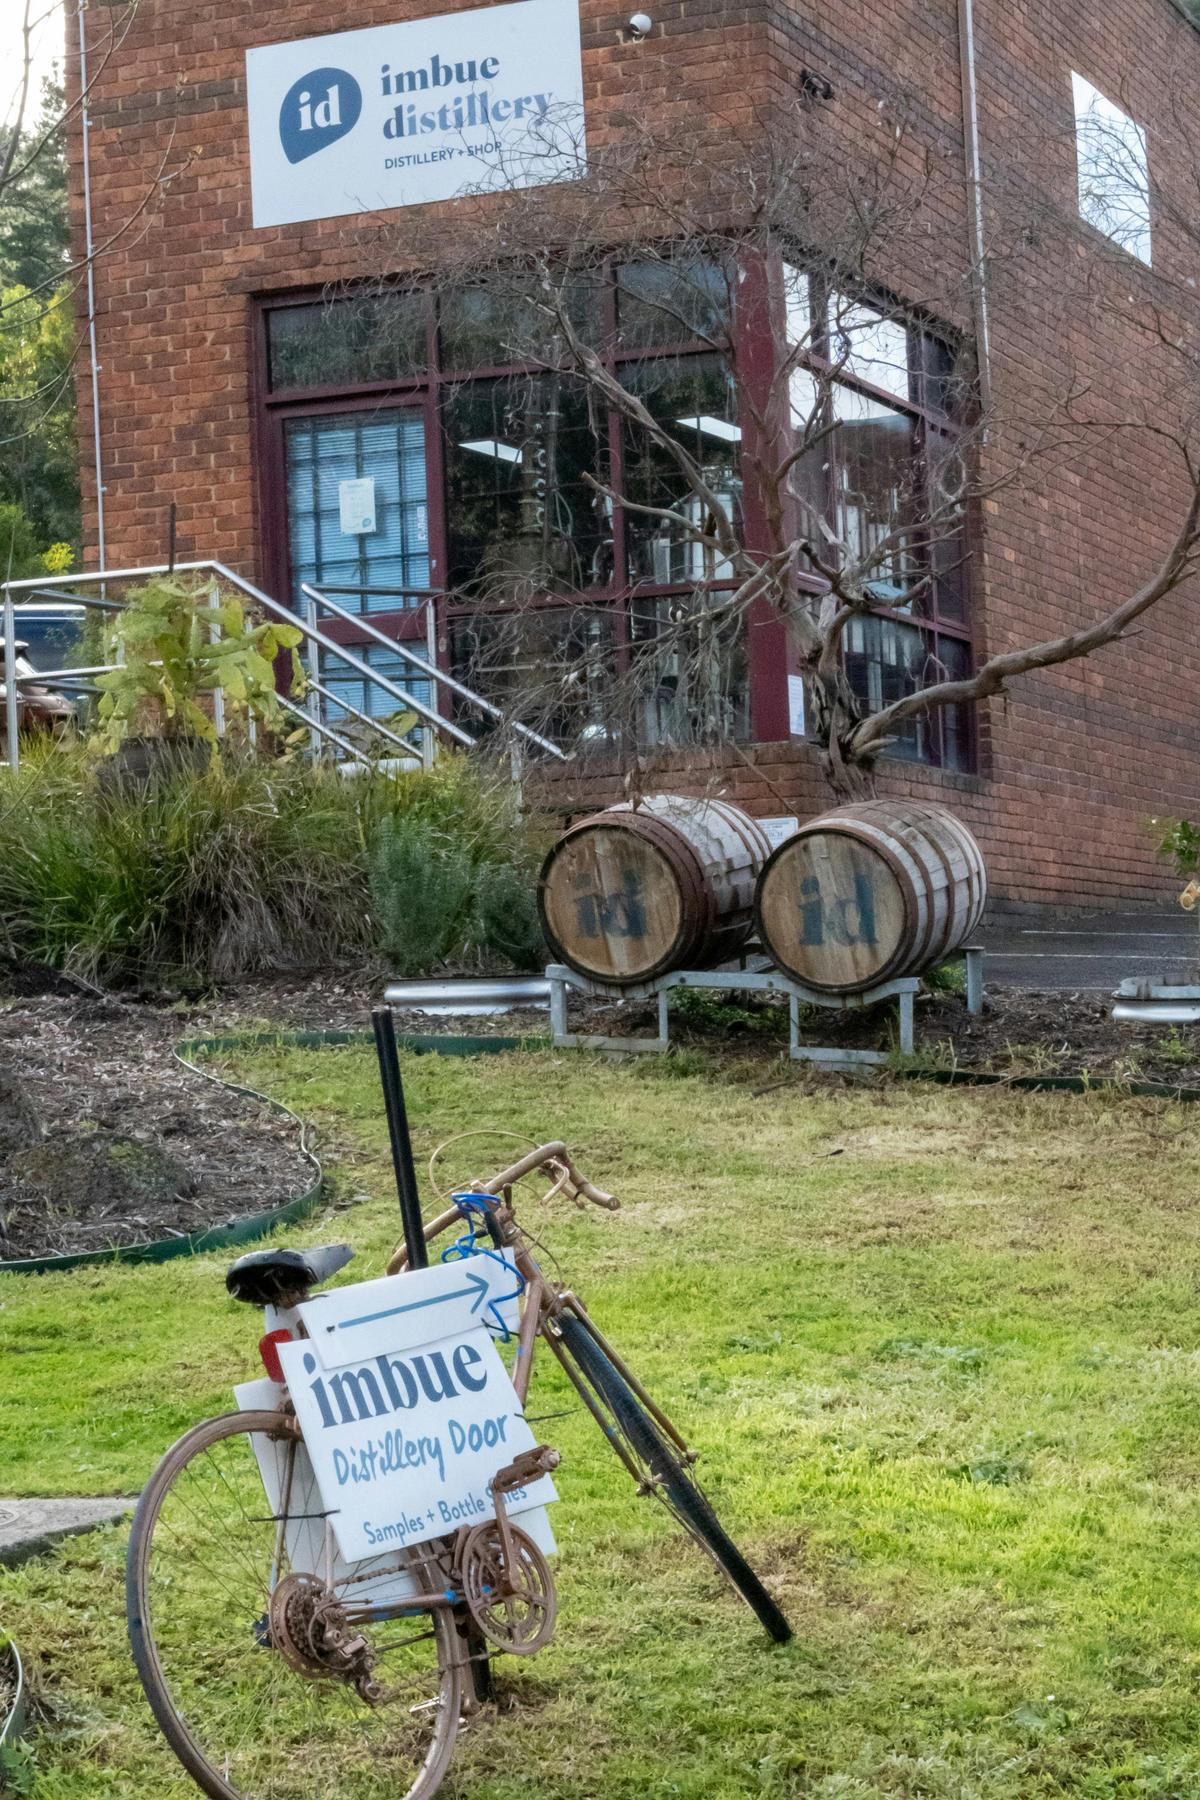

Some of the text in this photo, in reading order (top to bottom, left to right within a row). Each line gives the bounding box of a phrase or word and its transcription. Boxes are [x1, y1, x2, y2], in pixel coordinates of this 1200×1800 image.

[380, 54, 500, 96] imbue
[298, 84, 342, 131] id
[382, 90, 553, 140] distillery
[384, 149, 454, 170] DISTILLERY
[466, 141, 502, 157] SHOP
[575, 871, 649, 938] id
[800, 872, 880, 946] id
[303, 1344, 488, 1428] imbue
[332, 1413, 508, 1486] Distillery Door
[363, 1512, 425, 1545] Samples
[438, 1492, 486, 1524] Bottle
[485, 1486, 528, 1508] Sles
